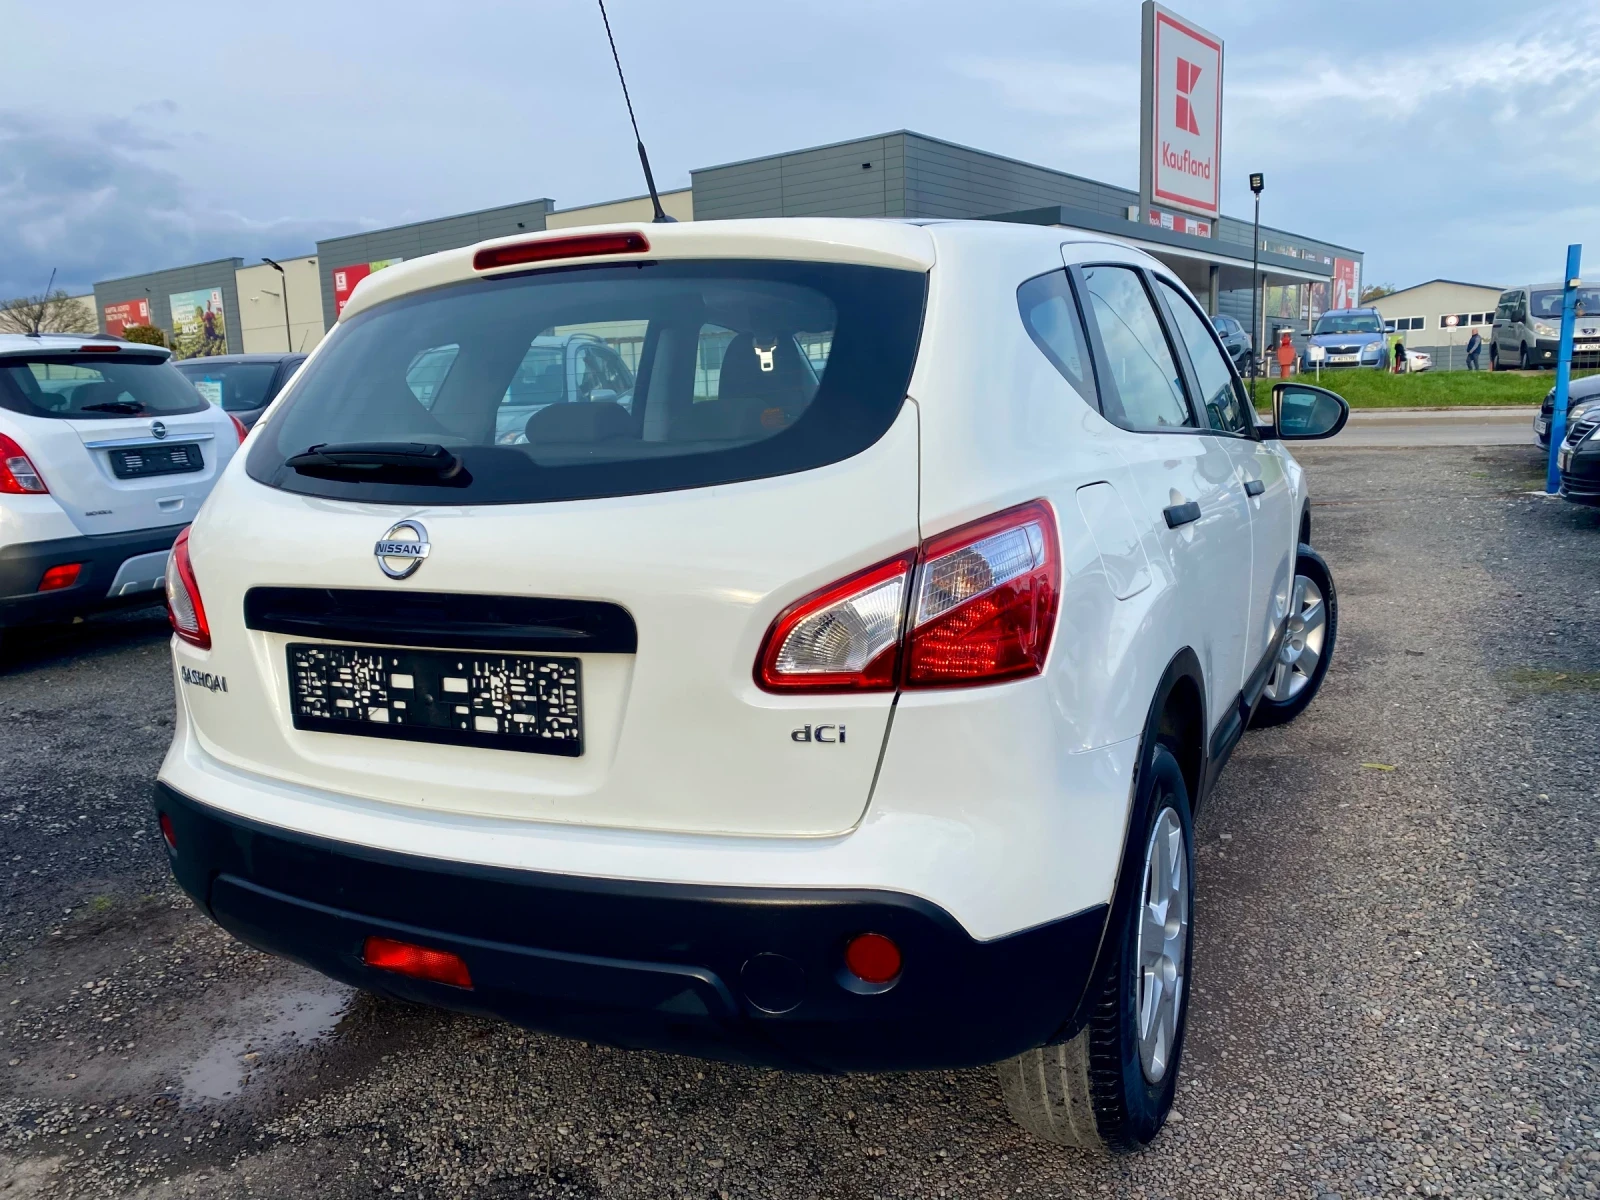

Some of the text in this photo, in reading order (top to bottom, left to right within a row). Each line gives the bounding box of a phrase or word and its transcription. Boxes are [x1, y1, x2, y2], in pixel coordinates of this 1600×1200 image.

[1176, 56, 1202, 136] K
[1162, 141, 1211, 179] Kaufland
[376, 542, 422, 555] NISSAN
[181, 665, 229, 693] QASHQAI
[790, 724, 846, 743] dCi
